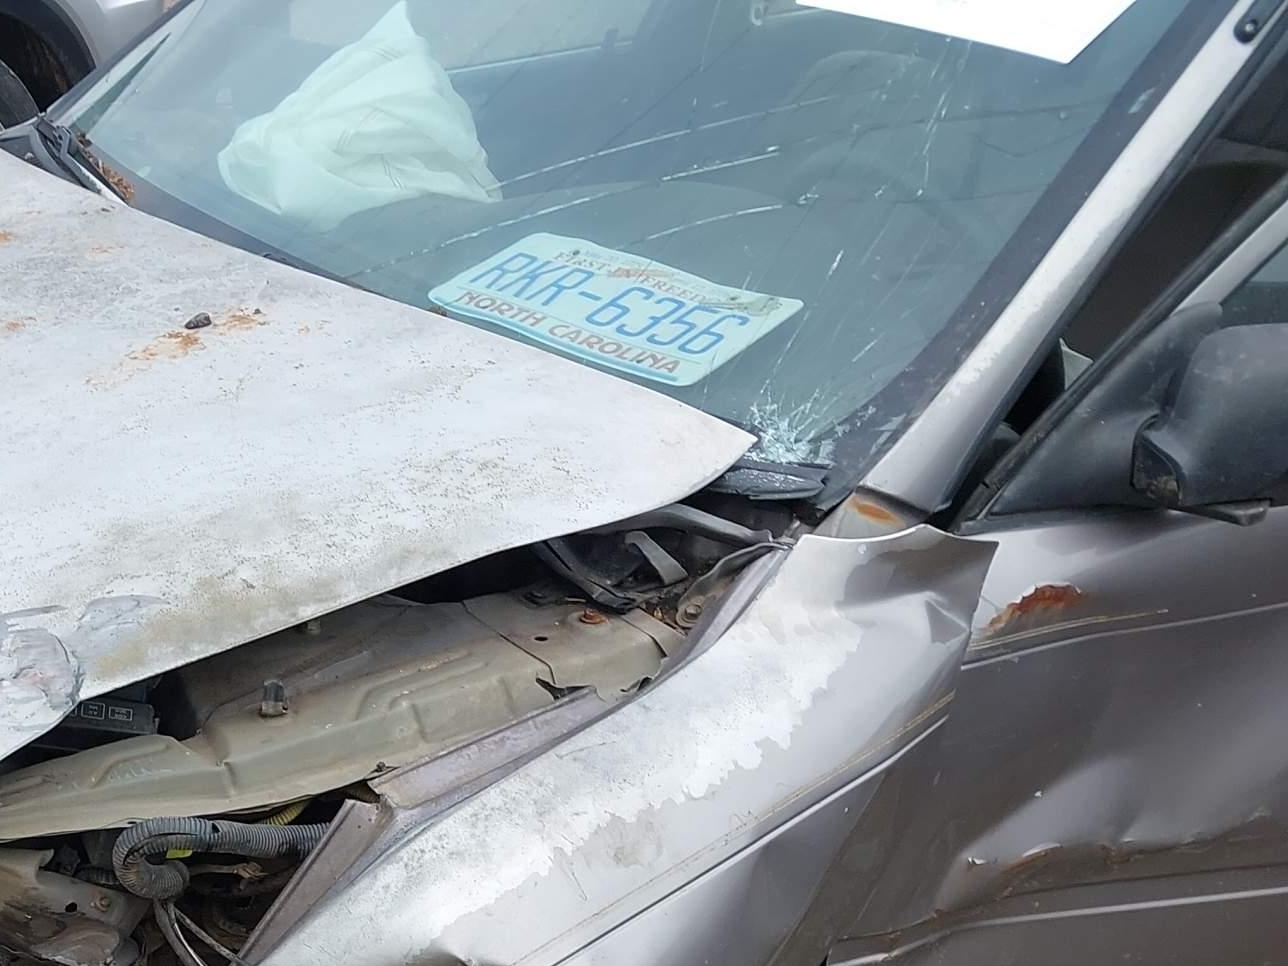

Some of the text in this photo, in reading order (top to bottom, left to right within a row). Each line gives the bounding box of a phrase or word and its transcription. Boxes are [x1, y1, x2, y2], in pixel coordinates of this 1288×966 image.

[469, 252, 750, 355] RKR-6356
[555, 251, 610, 271] FIRST
[641, 274, 722, 305] FREED
[456, 291, 682, 375] NORTH CAROLINA
